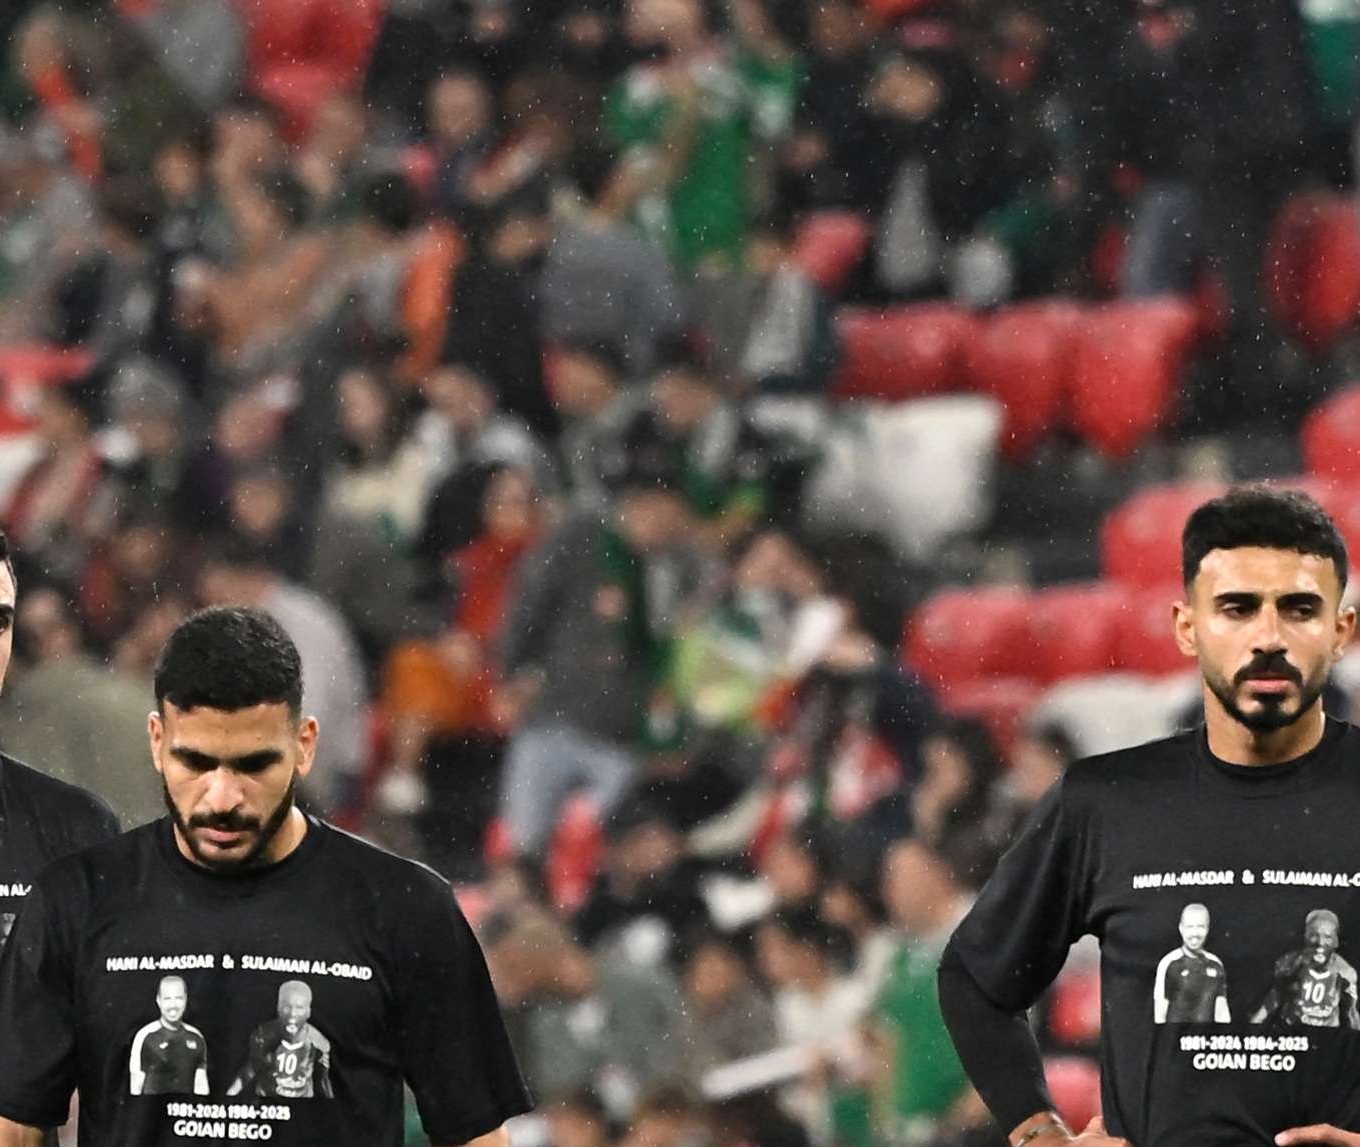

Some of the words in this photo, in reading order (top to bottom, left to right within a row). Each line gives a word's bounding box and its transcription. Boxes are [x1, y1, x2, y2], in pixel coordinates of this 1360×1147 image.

[1162, 870, 1234, 887] AL-MASDAR
[1242, 870, 1254, 884] &
[1262, 870, 1332, 887] SULAIMAN
[106, 957, 138, 971] HANI
[139, 954, 214, 970] AL-MASDAR
[222, 954, 234, 969] &
[241, 955, 309, 974] SULAIMAN
[311, 960, 372, 980] AL-OBAID
[1303, 981, 1325, 1003] 10
[1180, 1036, 1241, 1051] 1981-2024
[1244, 1036, 1309, 1051] 1984-2025
[276, 1053, 298, 1074] 10
[1193, 1053, 1246, 1070] GOIAN
[1249, 1053, 1295, 1071] BEGO
[166, 1103, 226, 1119] 1981-2024
[228, 1104, 290, 1120] 1984-2025
[174, 1120, 225, 1138] GOIAN
[228, 1122, 272, 1140] BEGO
